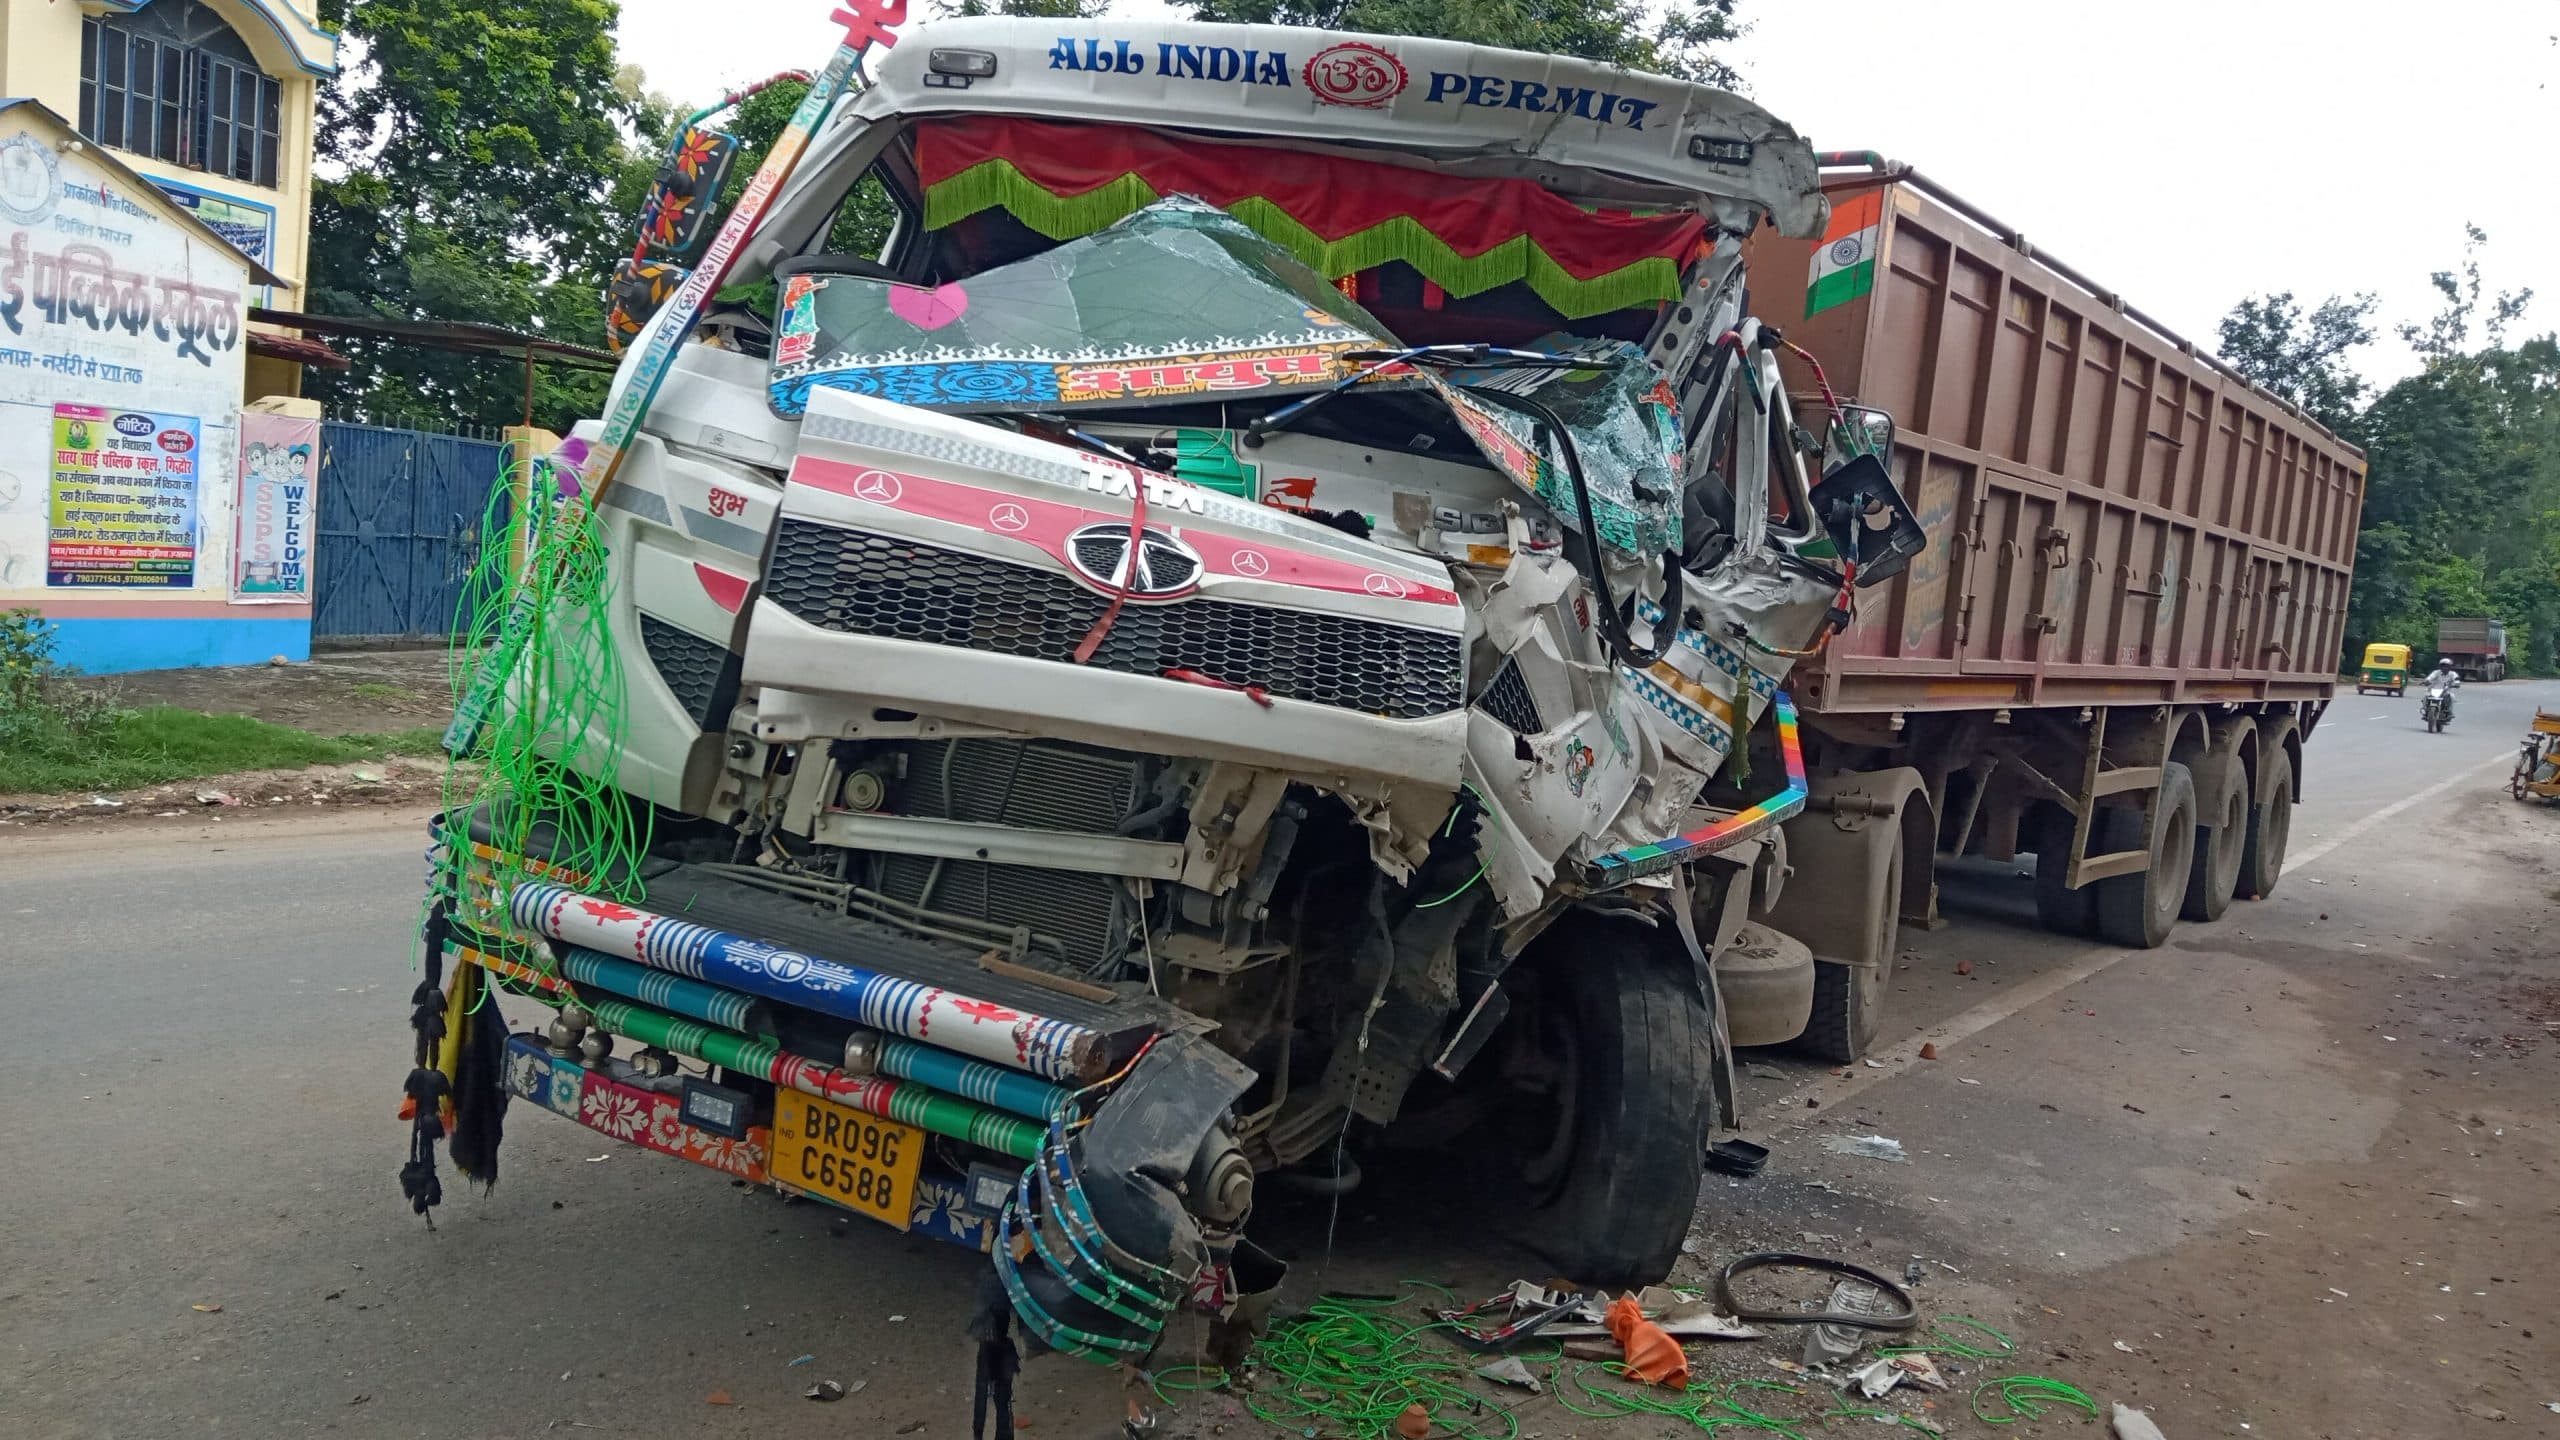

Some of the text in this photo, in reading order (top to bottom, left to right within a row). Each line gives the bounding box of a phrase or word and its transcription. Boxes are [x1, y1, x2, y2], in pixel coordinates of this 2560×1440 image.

[1049, 37, 1291, 88] ALL INDIA
[1423, 72, 1658, 132] PERMIT
[153, 276, 241, 367] स्कूल
[117, 418, 152, 434] नोटिस
[708, 487, 748, 517] शुभ
[1081, 467, 1204, 515] TATA
[281, 485, 304, 591] WELCOME
[805, 1104, 899, 1167] BR09G
[802, 1146, 893, 1209] C6588
